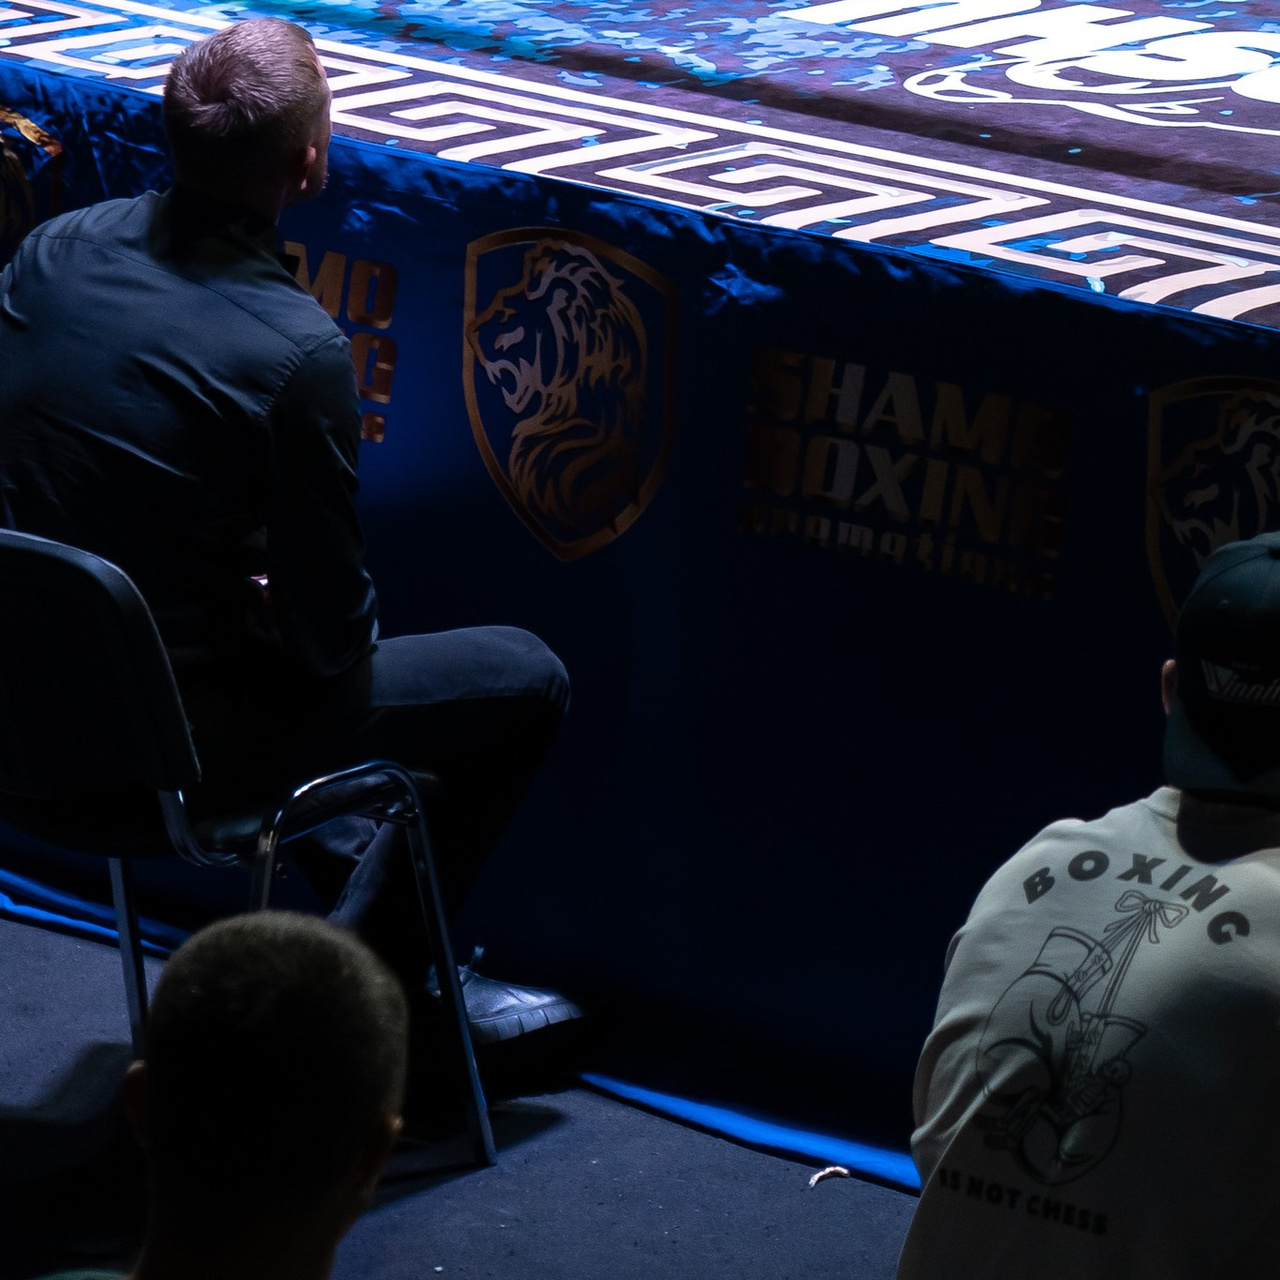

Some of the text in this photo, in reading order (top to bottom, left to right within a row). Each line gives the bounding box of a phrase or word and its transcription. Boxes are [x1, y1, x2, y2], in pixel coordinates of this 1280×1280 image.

[747, 345, 1076, 480] SHAMO
[744, 422, 1061, 561] BOXING
[1022, 850, 1250, 945] BOXING
[938, 1168, 1108, 1236] IS NOT CHESS
